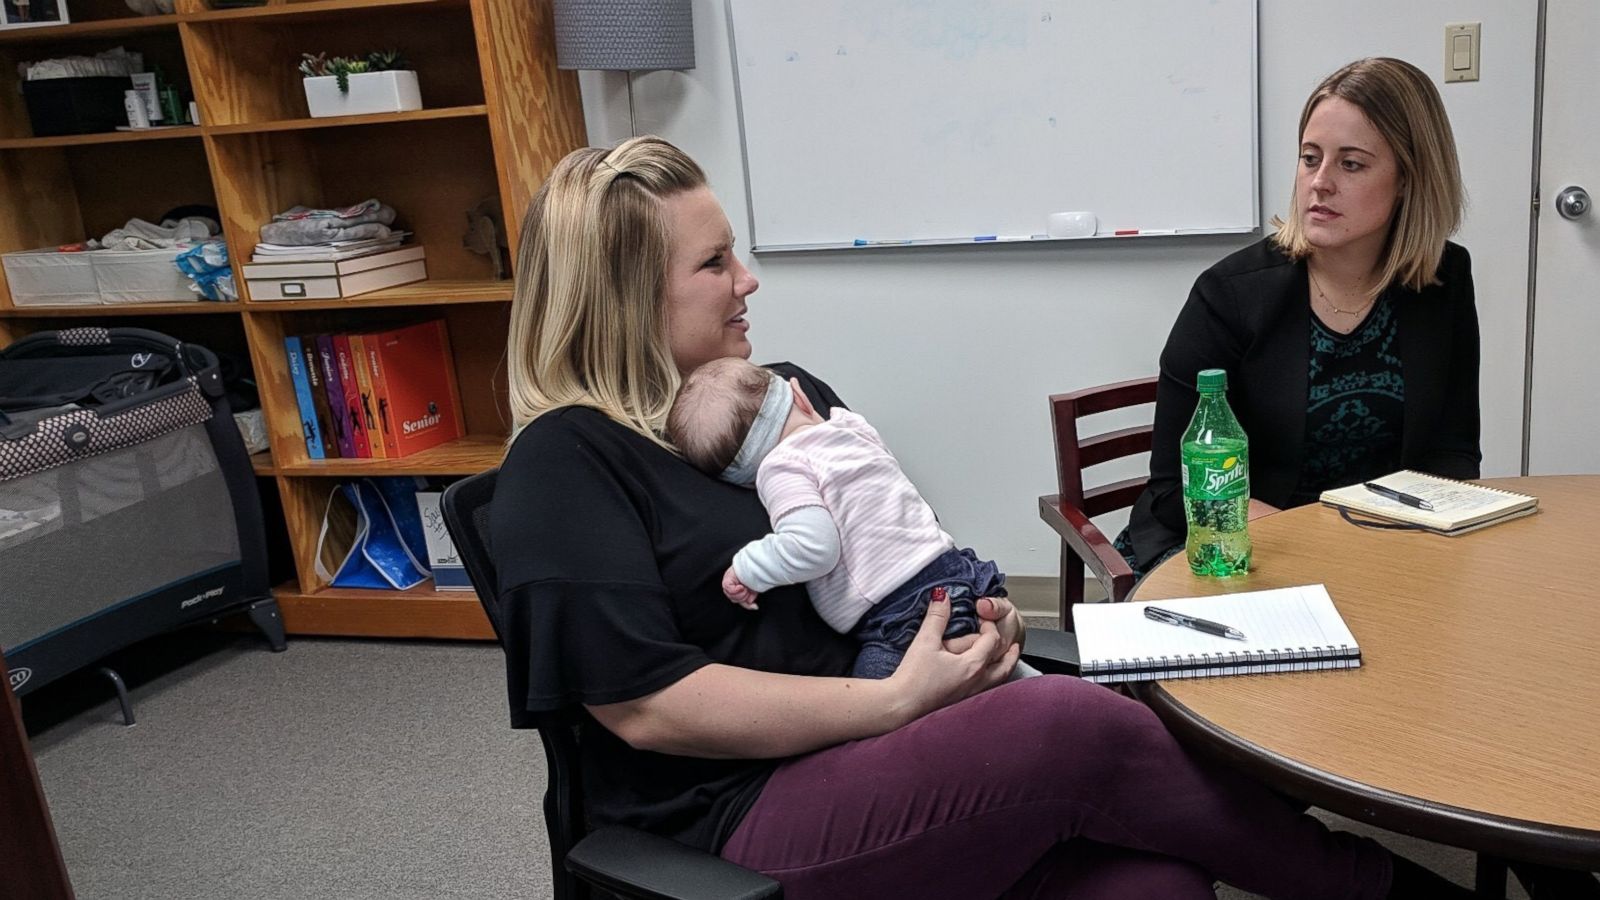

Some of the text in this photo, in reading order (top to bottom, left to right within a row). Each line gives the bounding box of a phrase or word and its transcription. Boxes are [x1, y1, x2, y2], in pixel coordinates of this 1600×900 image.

[290, 352, 300, 376] Daisy
[321, 351, 334, 382] Junior
[402, 414, 441, 435] Senior
[1206, 462, 1245, 491] Sprite
